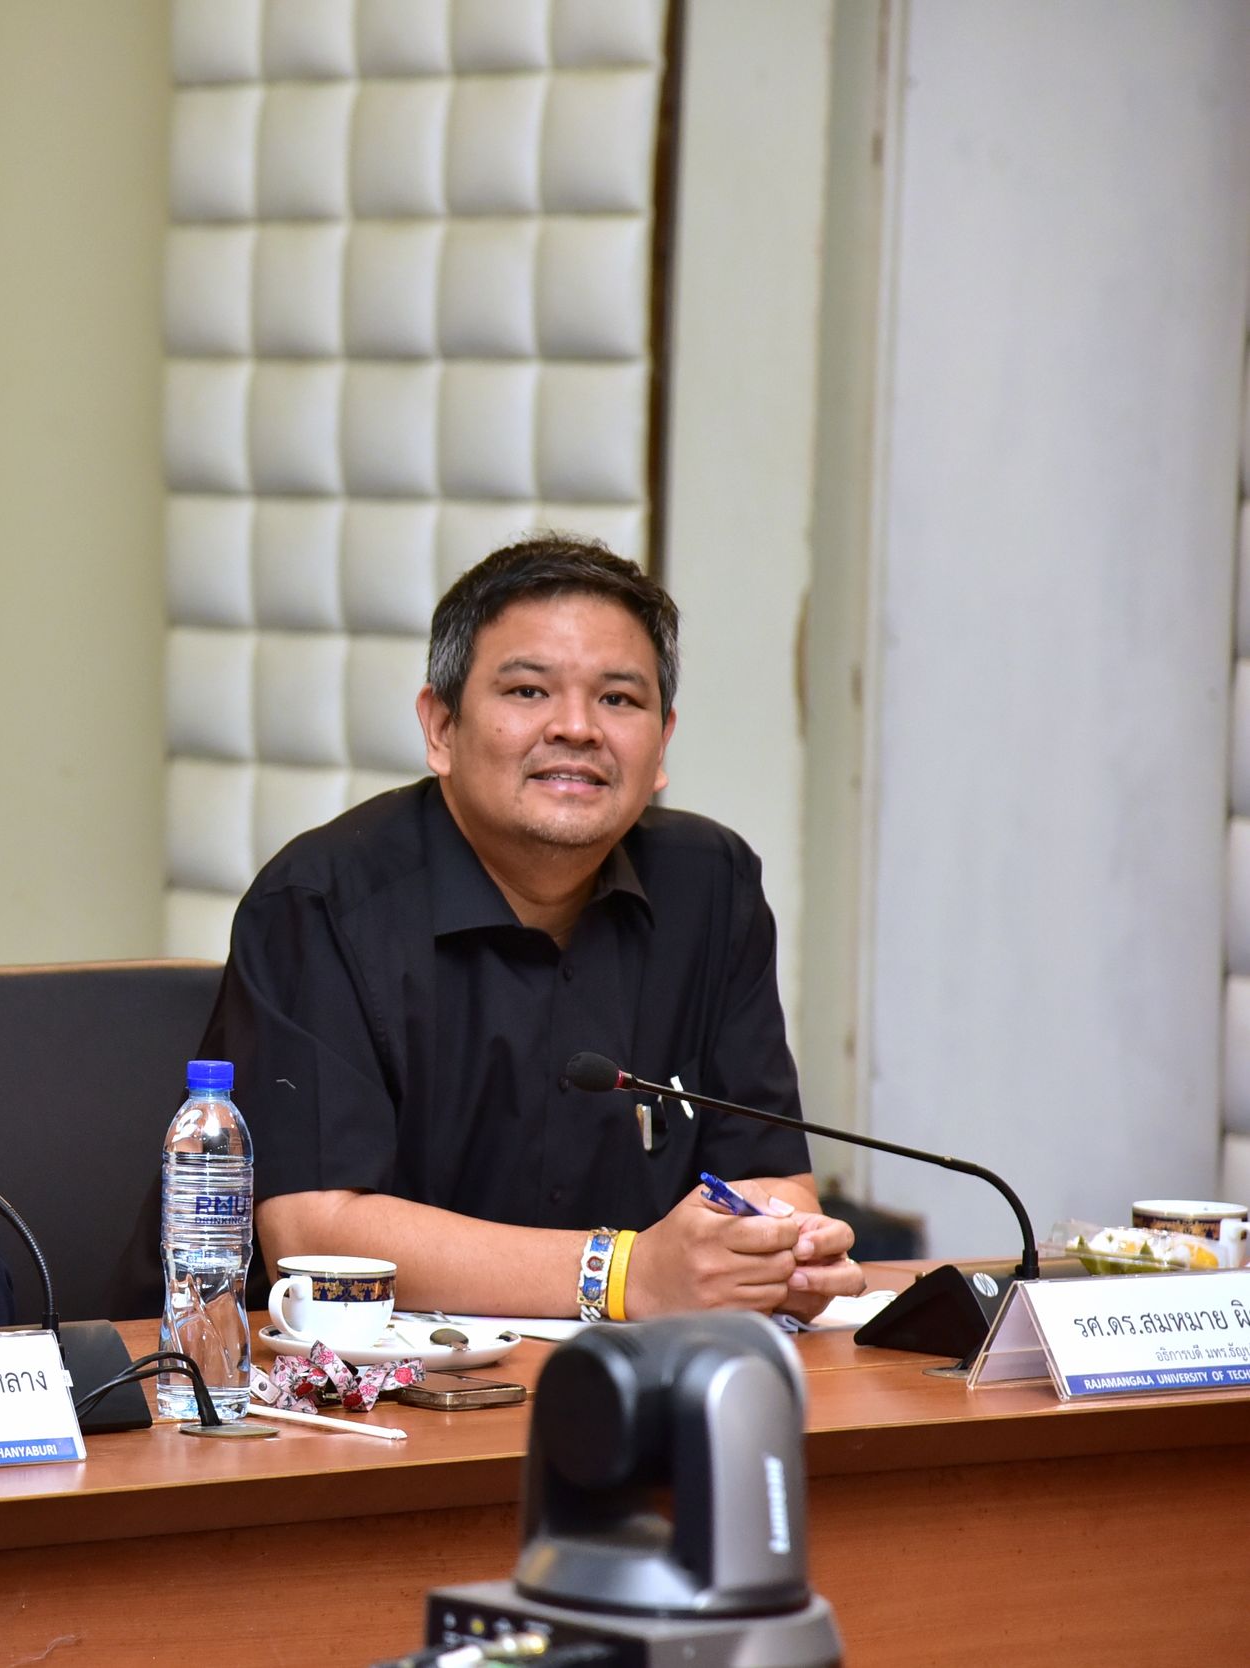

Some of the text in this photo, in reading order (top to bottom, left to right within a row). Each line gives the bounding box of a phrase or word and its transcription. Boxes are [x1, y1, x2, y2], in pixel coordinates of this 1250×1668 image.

[1074, 1310, 1228, 1338] รศ.ดร.สมหมาย
[1155, 1344, 1203, 1362] อธิการบดี
[1083, 1374, 1155, 1390] RAJAMANGALA
[1156, 1371, 1209, 1385] UNIVERSITY
[1212, 1370, 1224, 1382] OF
